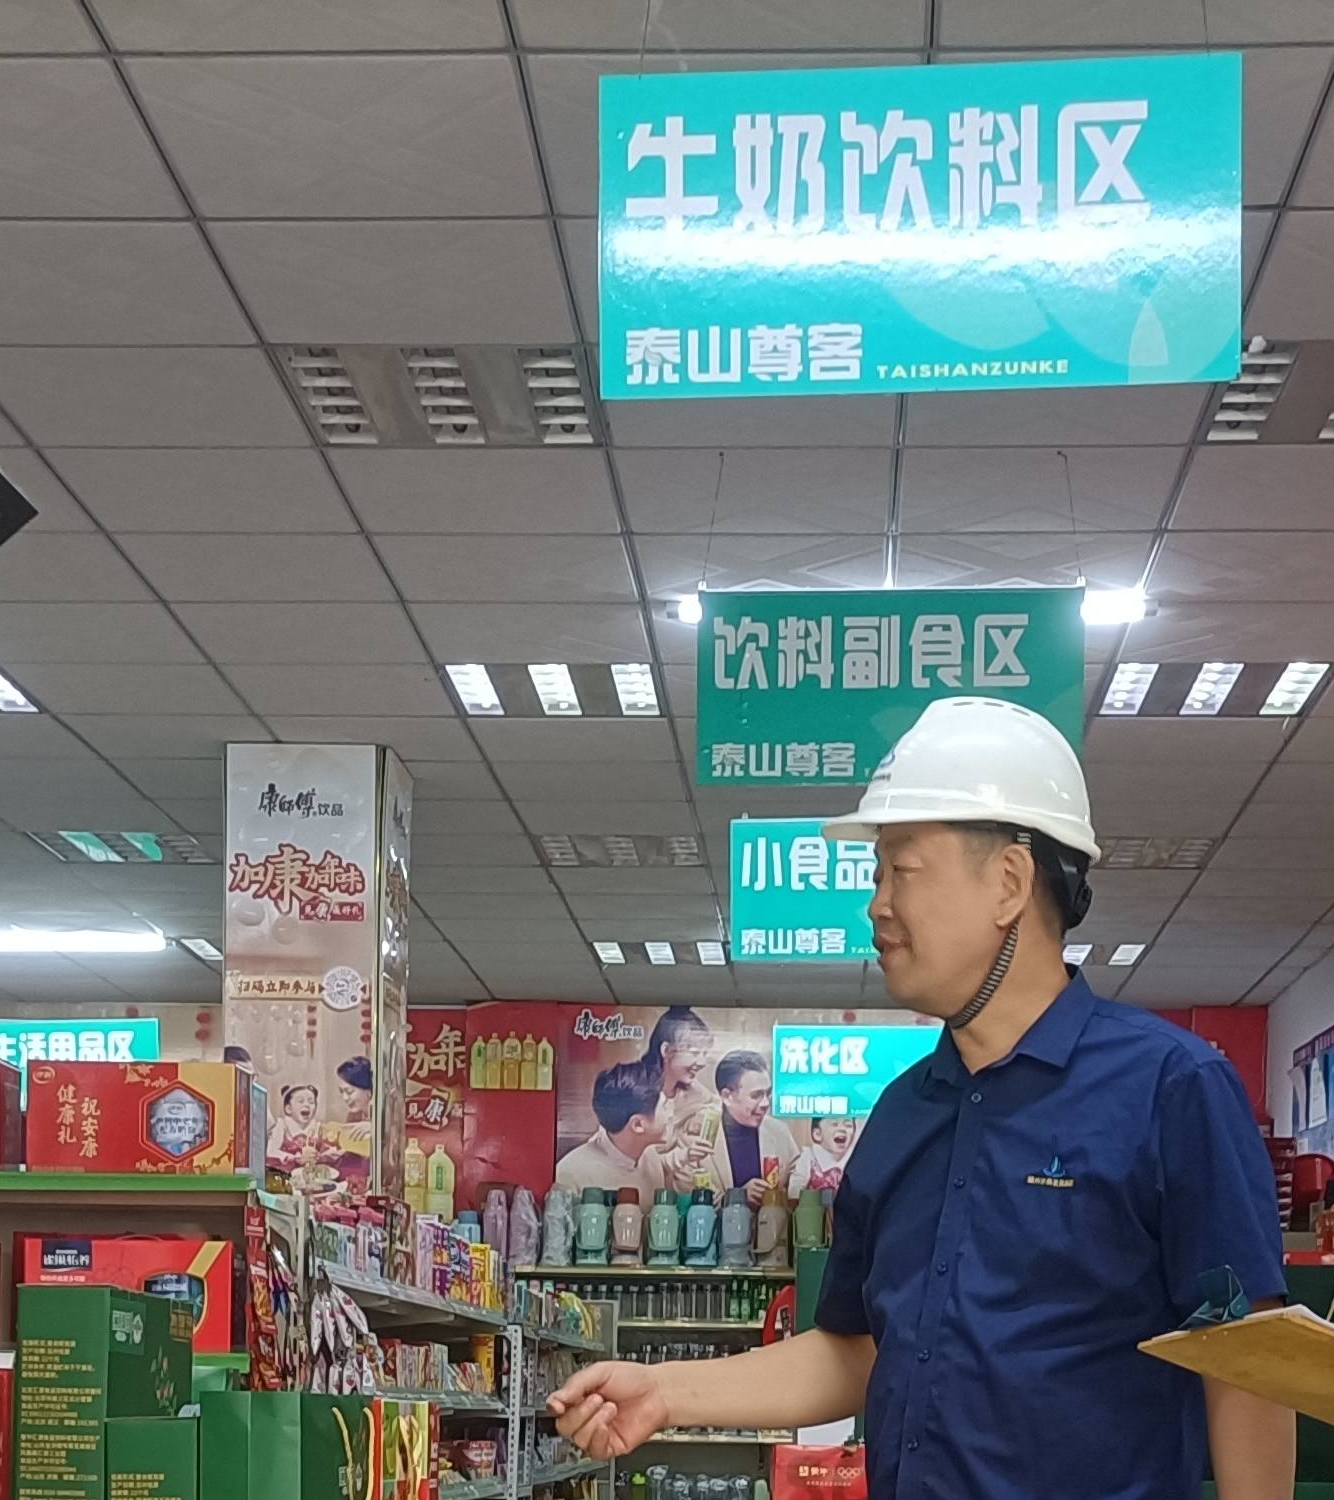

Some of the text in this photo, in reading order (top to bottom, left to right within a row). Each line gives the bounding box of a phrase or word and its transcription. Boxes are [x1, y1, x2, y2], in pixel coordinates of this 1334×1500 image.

[625, 98, 1151, 238] 牛奶饮料区
[625, 322, 863, 385] 泰山尊客
[876, 357, 1068, 381] TAISHANZUNKE
[713, 613, 1031, 691] 饮料副食区
[711, 742, 856, 778] 泰山尊客
[740, 836, 879, 892] 小食品
[740, 928, 846, 955] 泰山尊客
[238, 979, 317, 995] 扫码立即参与
[780, 1035, 869, 1074] 洗化区
[57, 1084, 78, 1145] 健康礼
[79, 1096, 102, 1158] 祝安康
